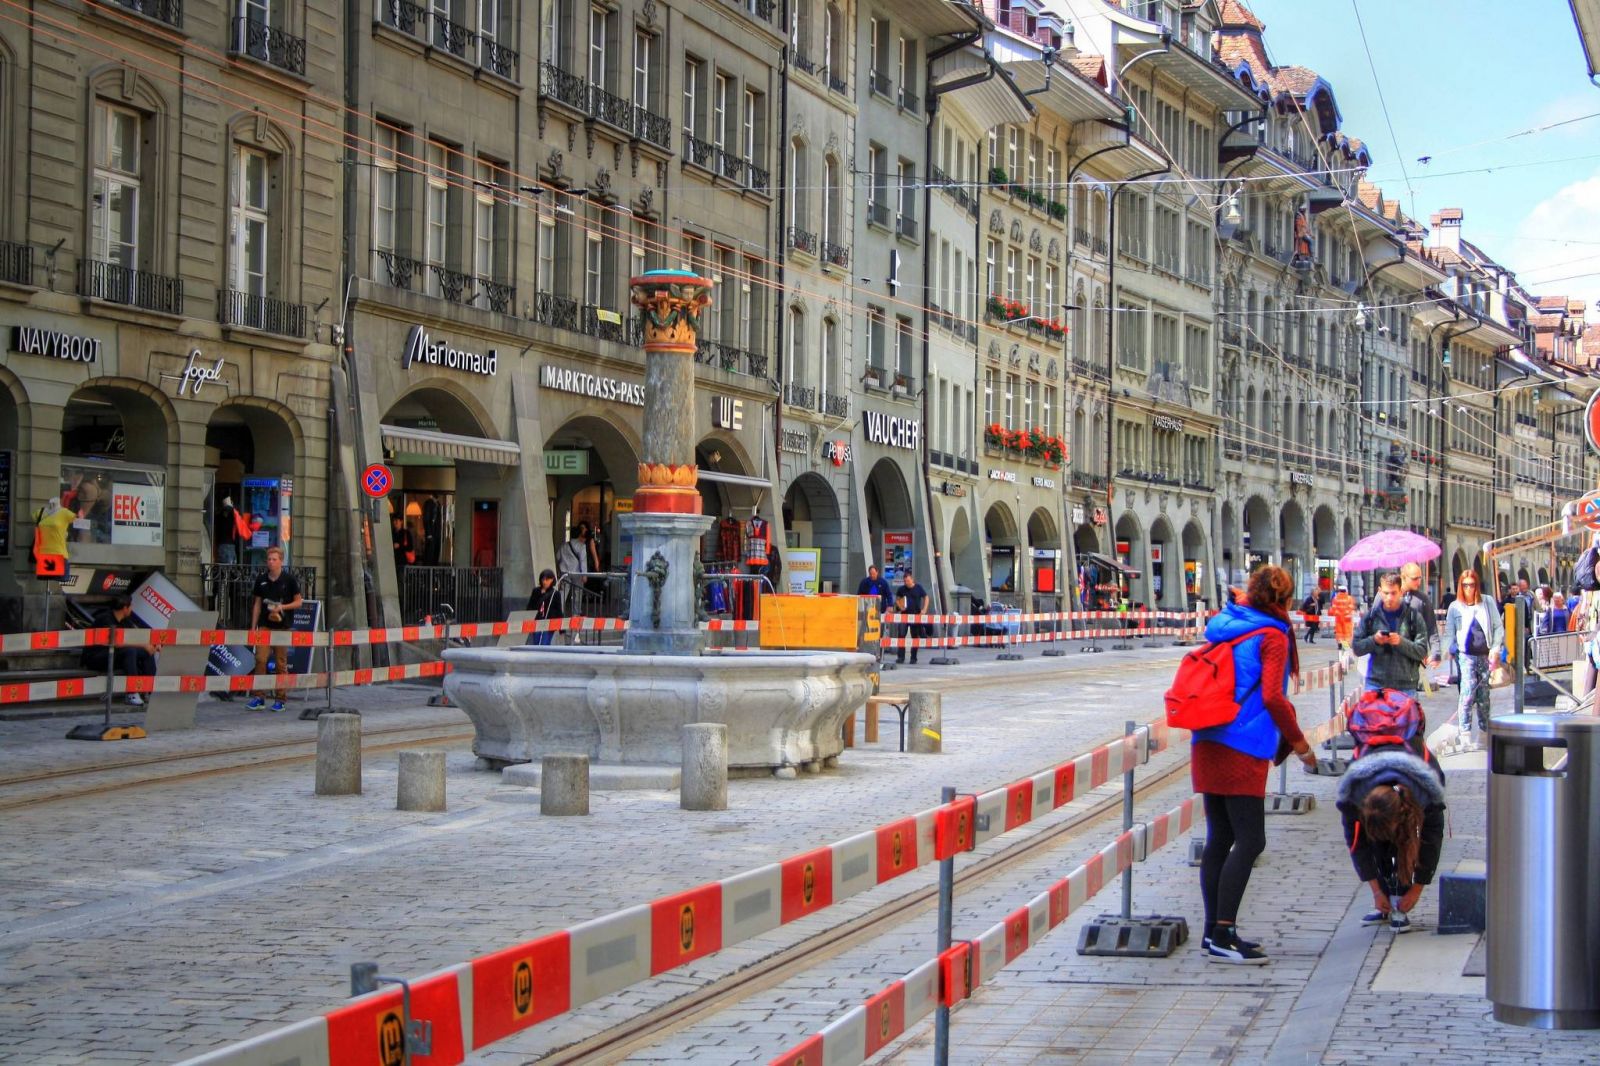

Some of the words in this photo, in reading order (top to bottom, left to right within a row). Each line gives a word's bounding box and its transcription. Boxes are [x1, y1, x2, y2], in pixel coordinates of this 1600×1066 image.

[19, 326, 101, 362] NAVYBOOT
[407, 324, 498, 377] Marionnaud
[179, 349, 224, 395] fogal
[719, 396, 743, 430] WE
[867, 410, 919, 450] VAUCHER
[547, 454, 577, 470] WE
